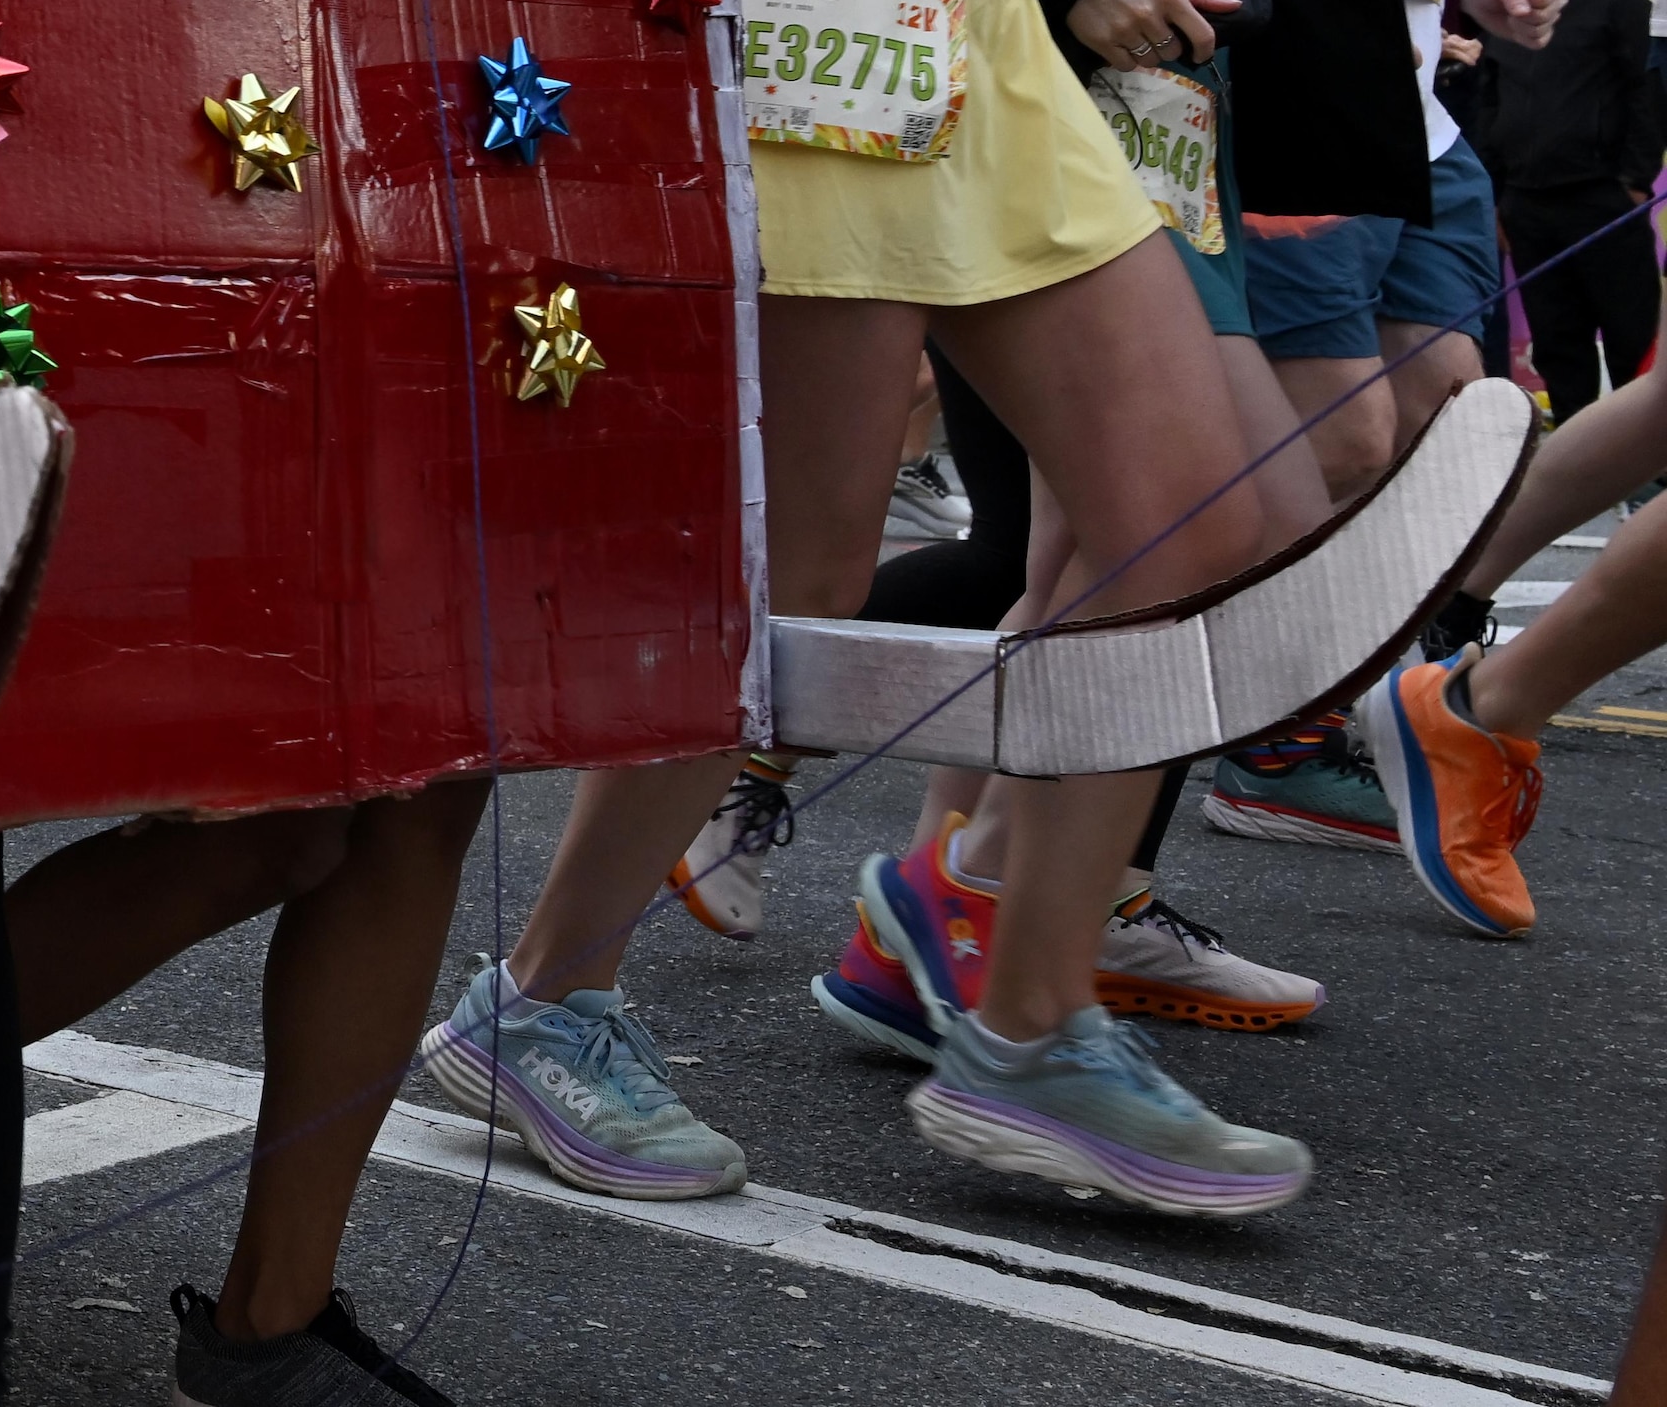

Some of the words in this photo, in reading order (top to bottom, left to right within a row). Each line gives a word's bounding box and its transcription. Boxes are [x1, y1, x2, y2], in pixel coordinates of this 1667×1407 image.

[896, 2, 938, 32] 12K
[745, 20, 937, 102] E32775
[1100, 110, 1204, 192] 36543
[516, 1045, 601, 1121] HOKA
